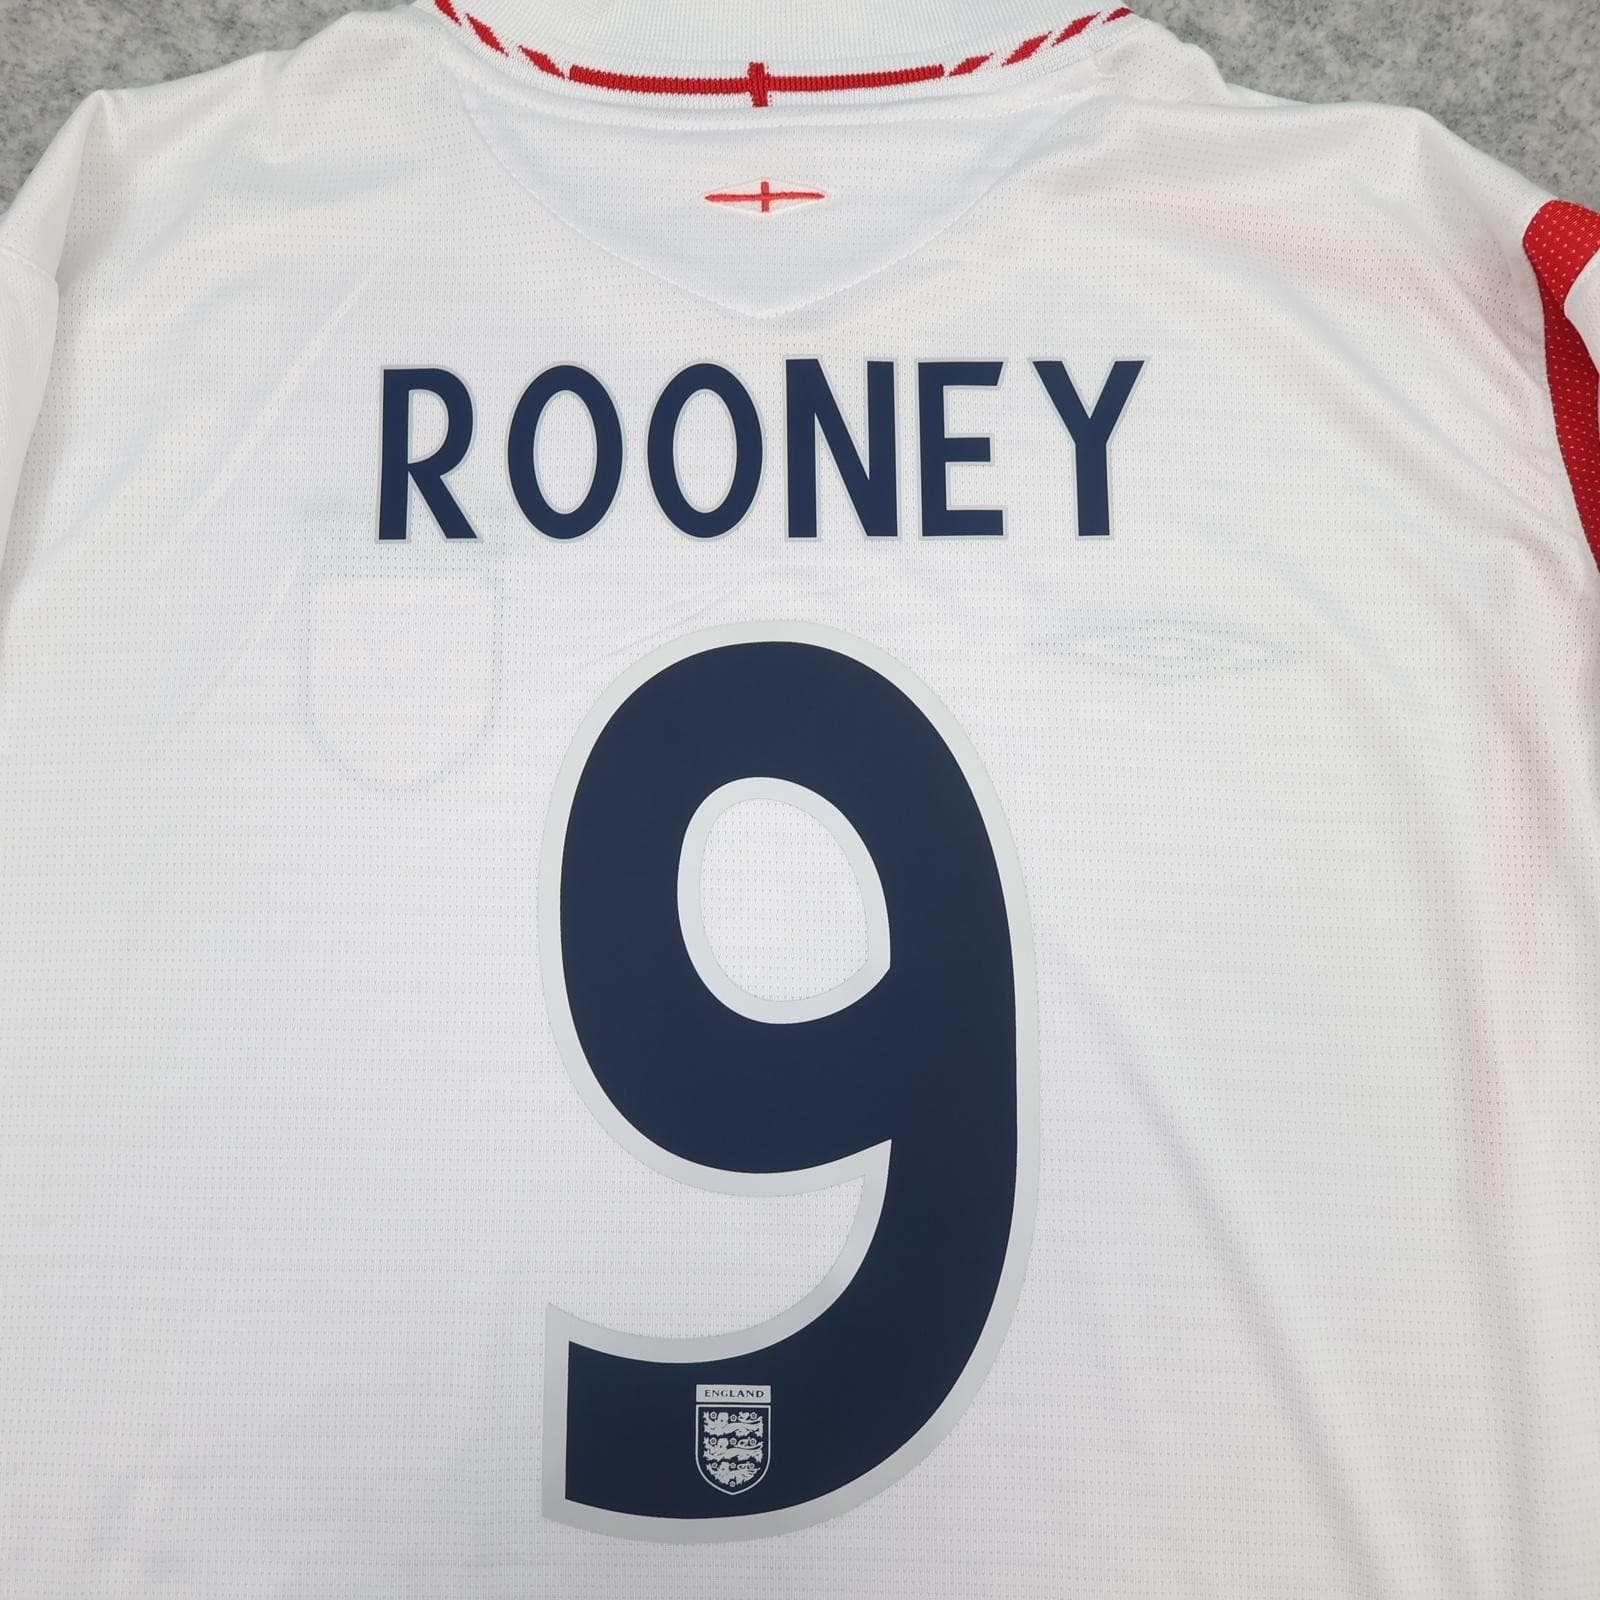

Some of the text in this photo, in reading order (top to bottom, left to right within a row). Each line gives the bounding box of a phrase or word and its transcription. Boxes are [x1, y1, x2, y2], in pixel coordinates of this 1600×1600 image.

[377, 357, 1147, 541] ROONEY
[550, 631, 1028, 1531] 9
[704, 1389, 764, 1398] ENGLAND
